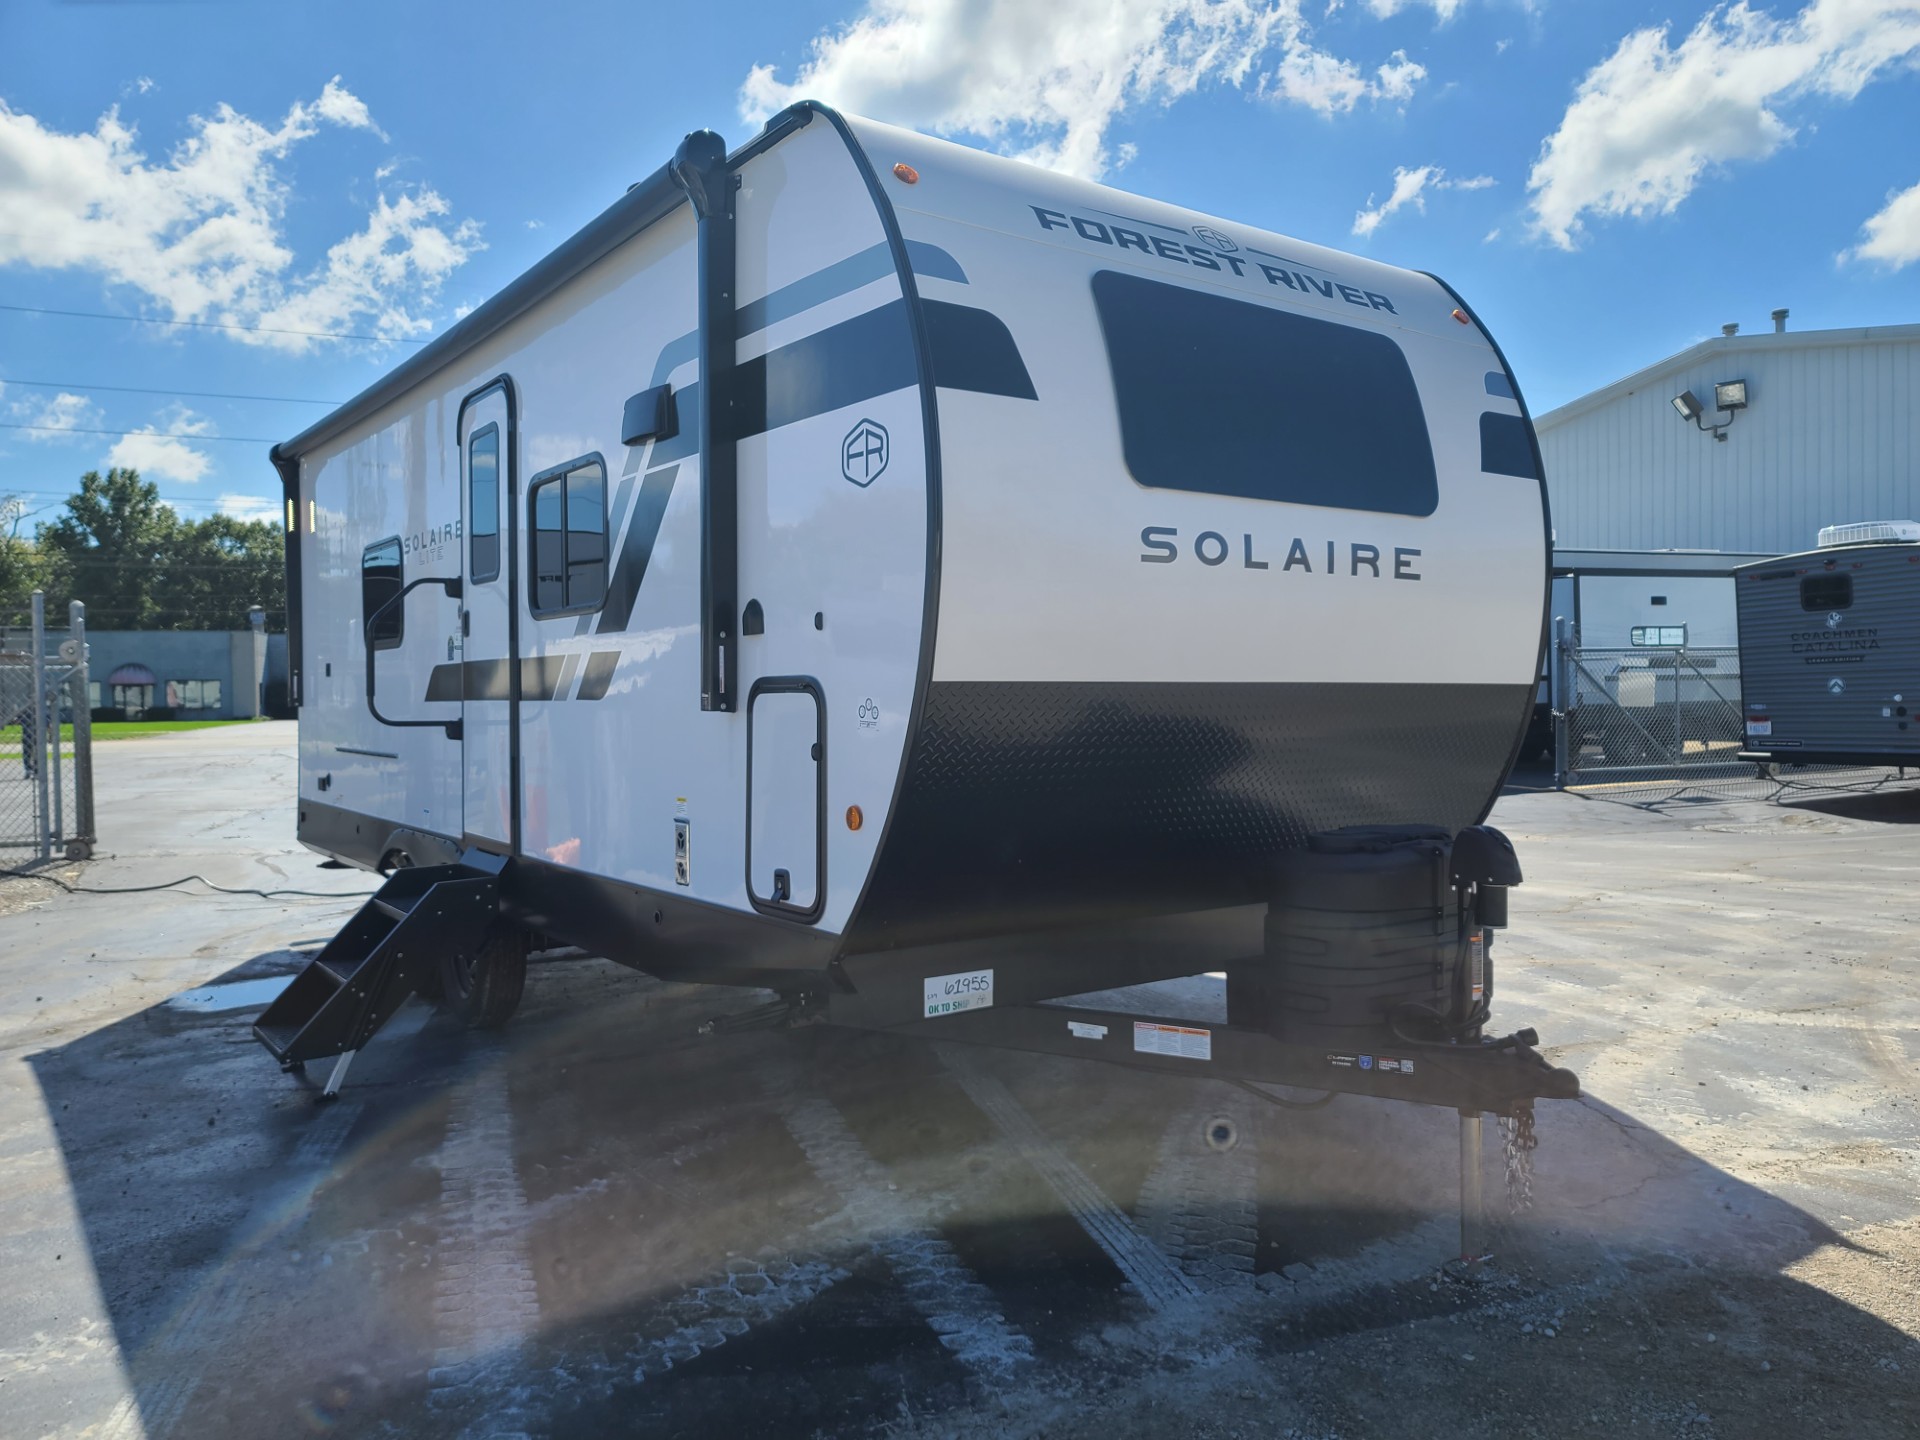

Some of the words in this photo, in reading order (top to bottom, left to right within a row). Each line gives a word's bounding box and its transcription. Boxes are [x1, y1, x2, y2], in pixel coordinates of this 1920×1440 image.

[1028, 204, 1246, 277] FOREST
[1255, 262, 1400, 316] RIVER
[404, 519, 462, 555] SOLAIRE
[418, 545, 444, 566] LITE
[1140, 526, 1422, 581] SOLAIRE
[1791, 628, 1878, 641] COACHMEN
[1791, 638, 1881, 653] CATALINA
[944, 975, 990, 996] 61955
[928, 1003, 940, 1015] OK
[942, 1002, 951, 1013] TO
